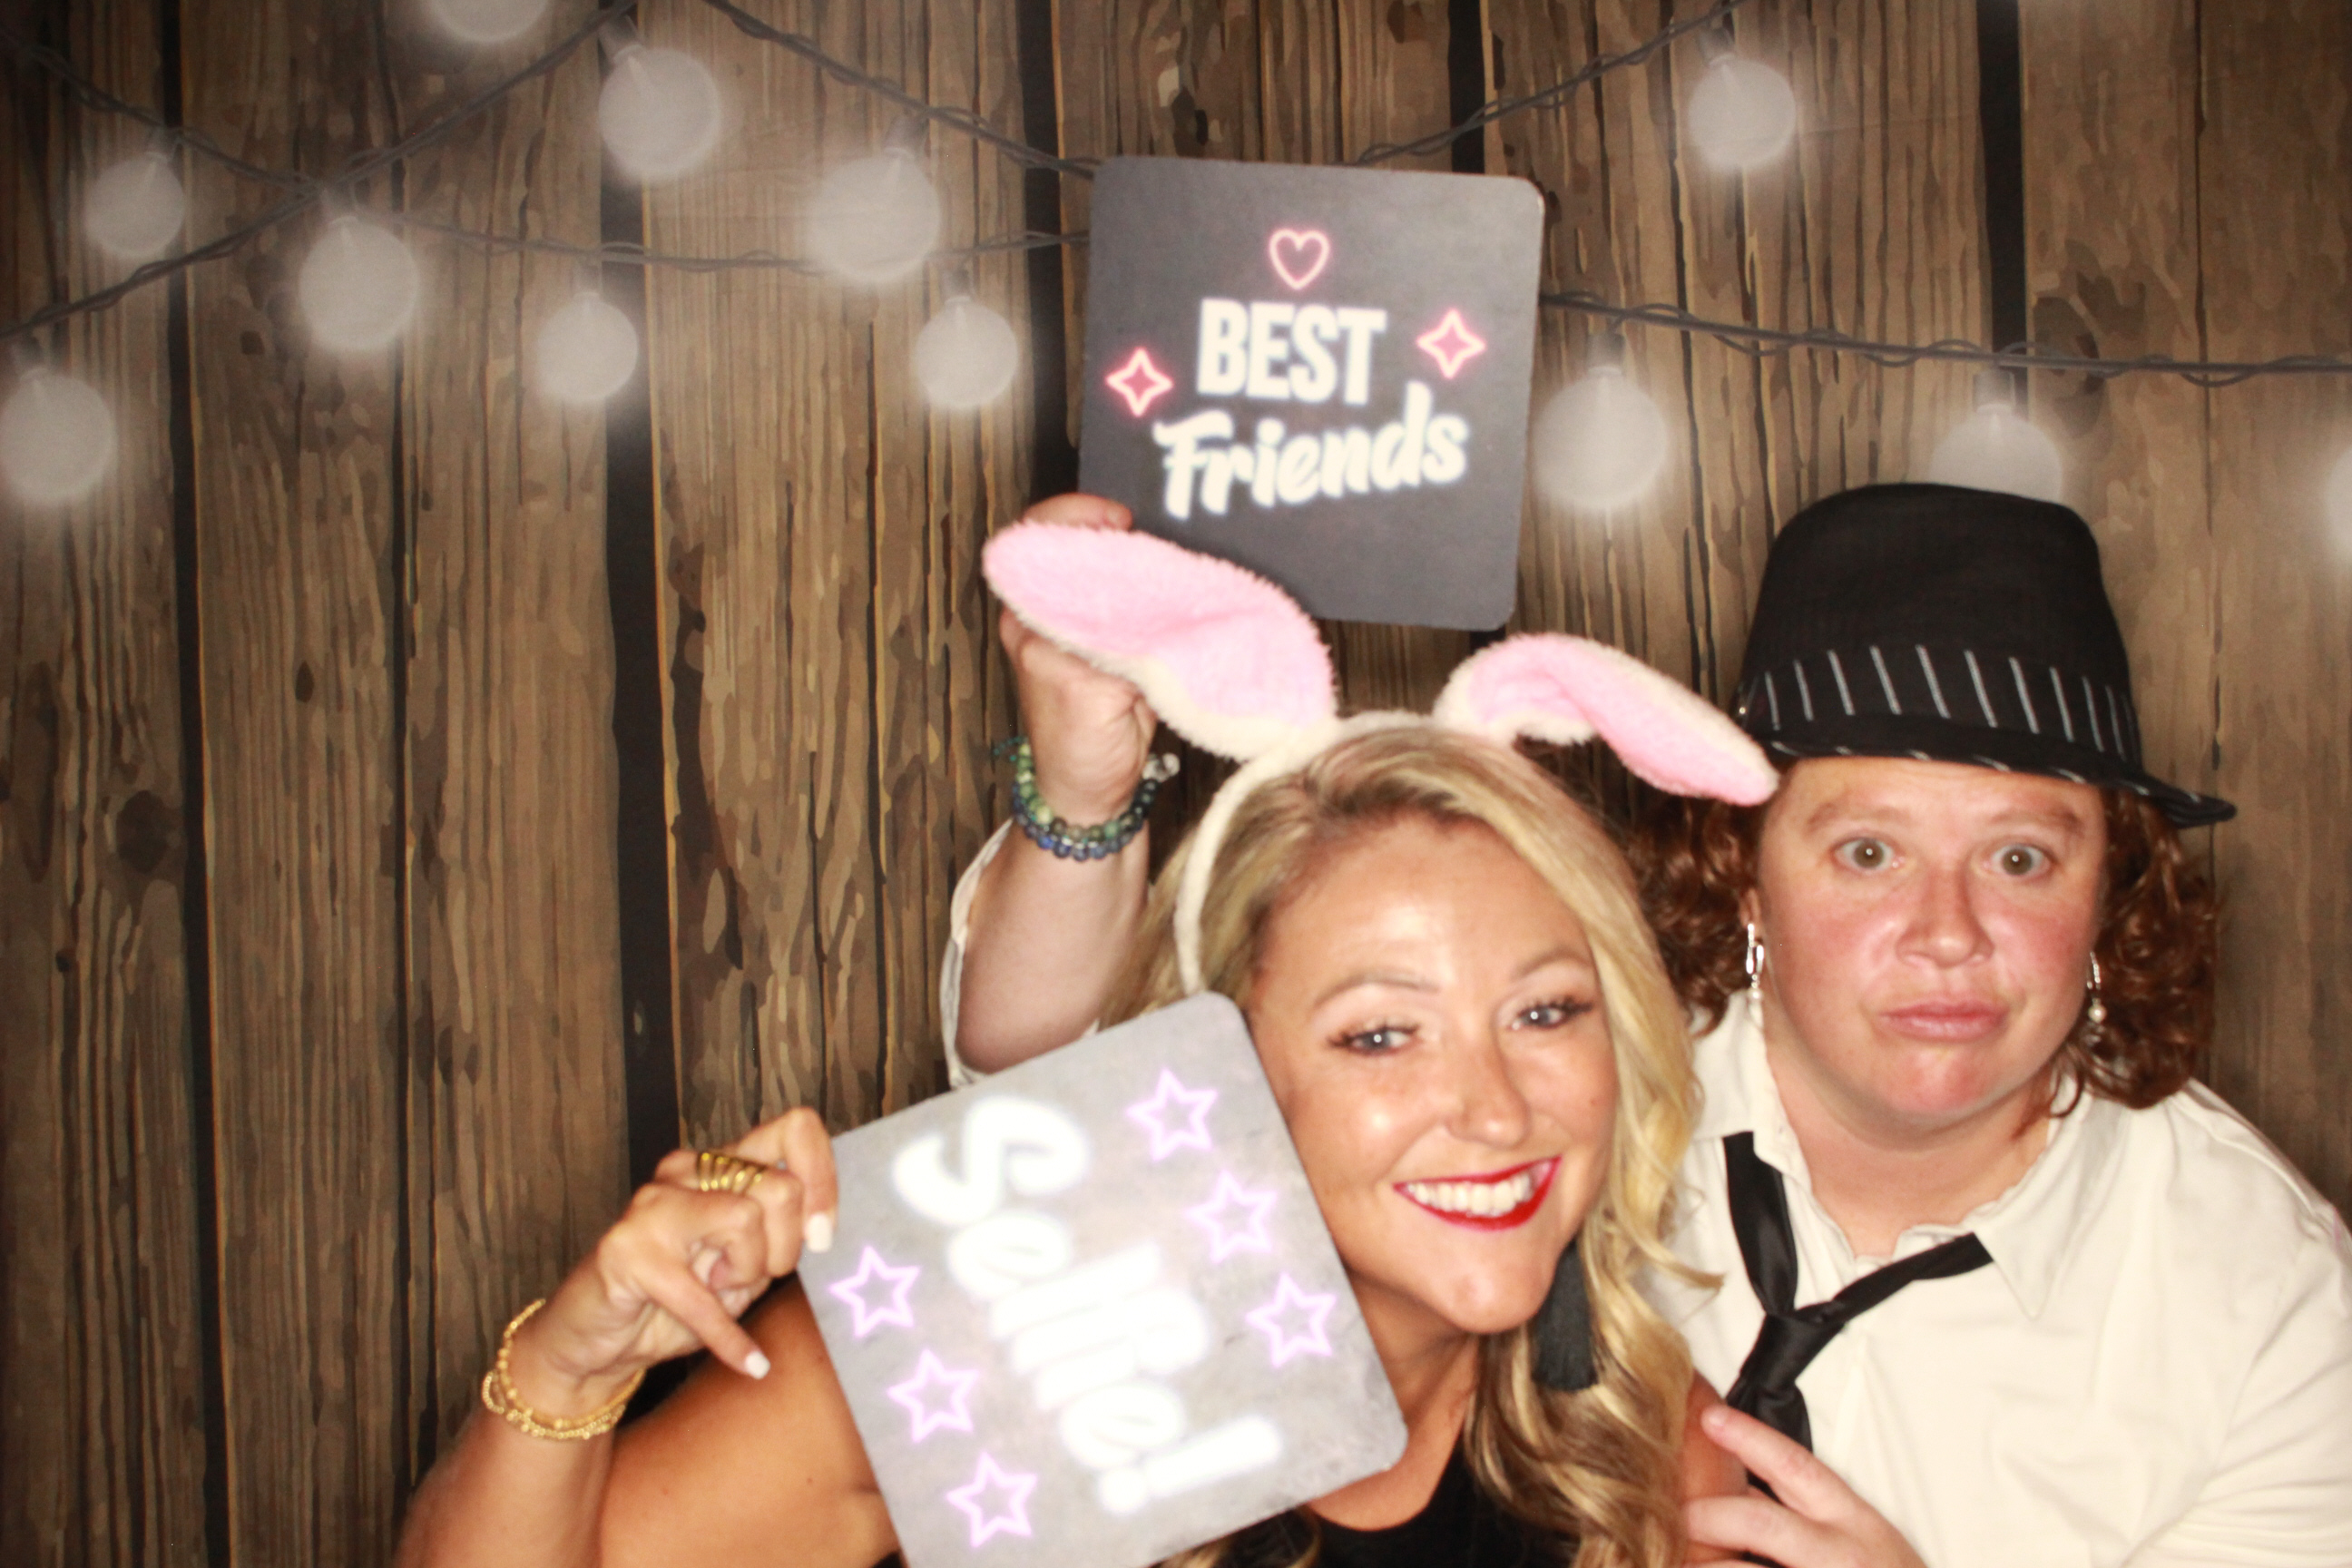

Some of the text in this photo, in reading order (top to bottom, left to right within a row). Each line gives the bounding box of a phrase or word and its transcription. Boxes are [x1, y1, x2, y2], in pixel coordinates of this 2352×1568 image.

[1197, 298, 1387, 405] BEST
[1152, 381, 1469, 520] Friends
[891, 1095, 1283, 1514] Selfie!
